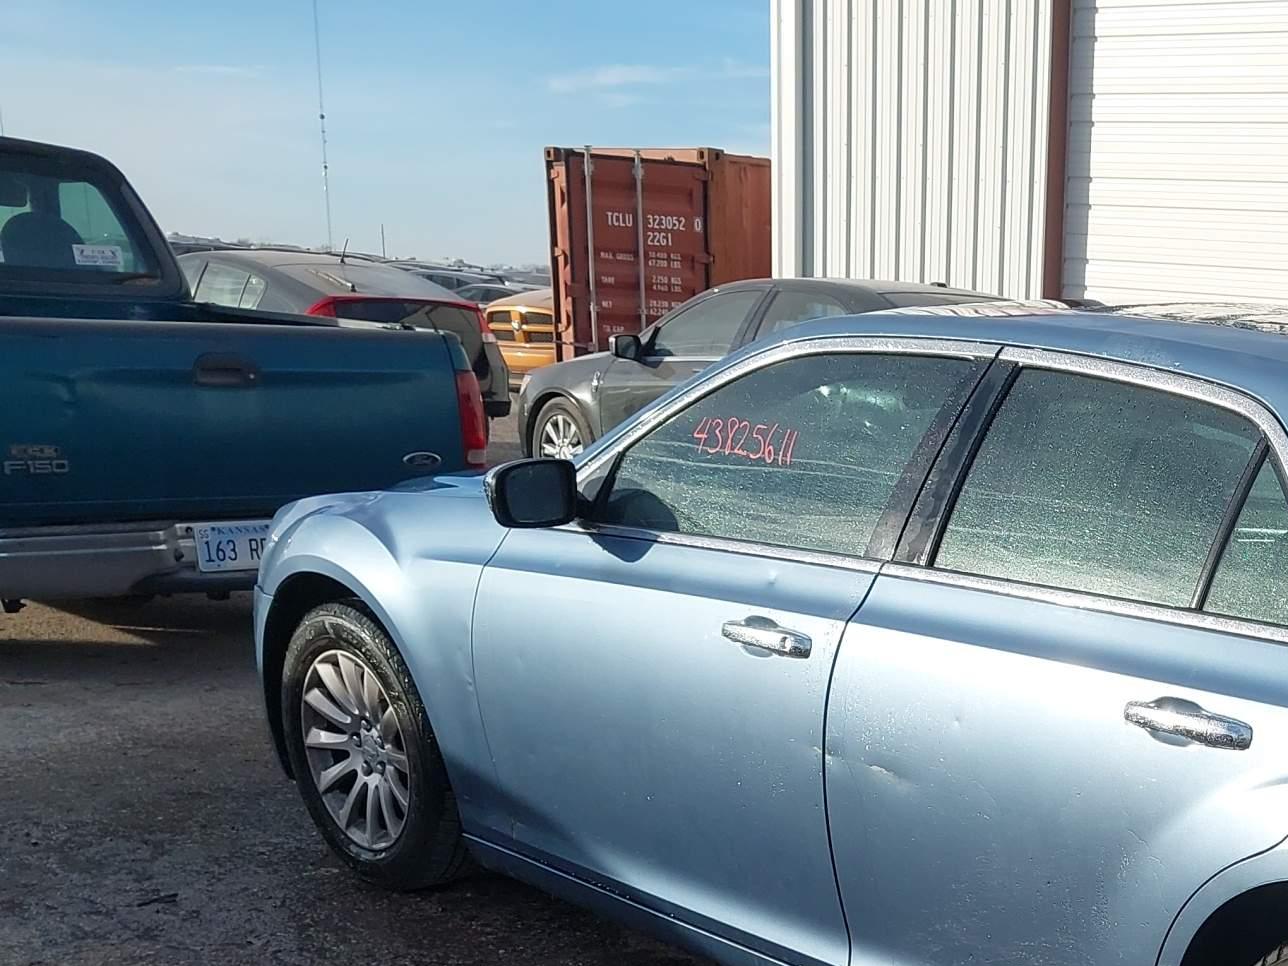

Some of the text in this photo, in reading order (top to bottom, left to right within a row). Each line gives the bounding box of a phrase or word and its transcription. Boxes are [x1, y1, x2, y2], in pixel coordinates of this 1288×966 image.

[606, 212, 702, 231] TCLU 323052 0
[647, 232, 673, 246] 22G1
[693, 417, 798, 466] 43825611
[204, 540, 238, 562] 163
